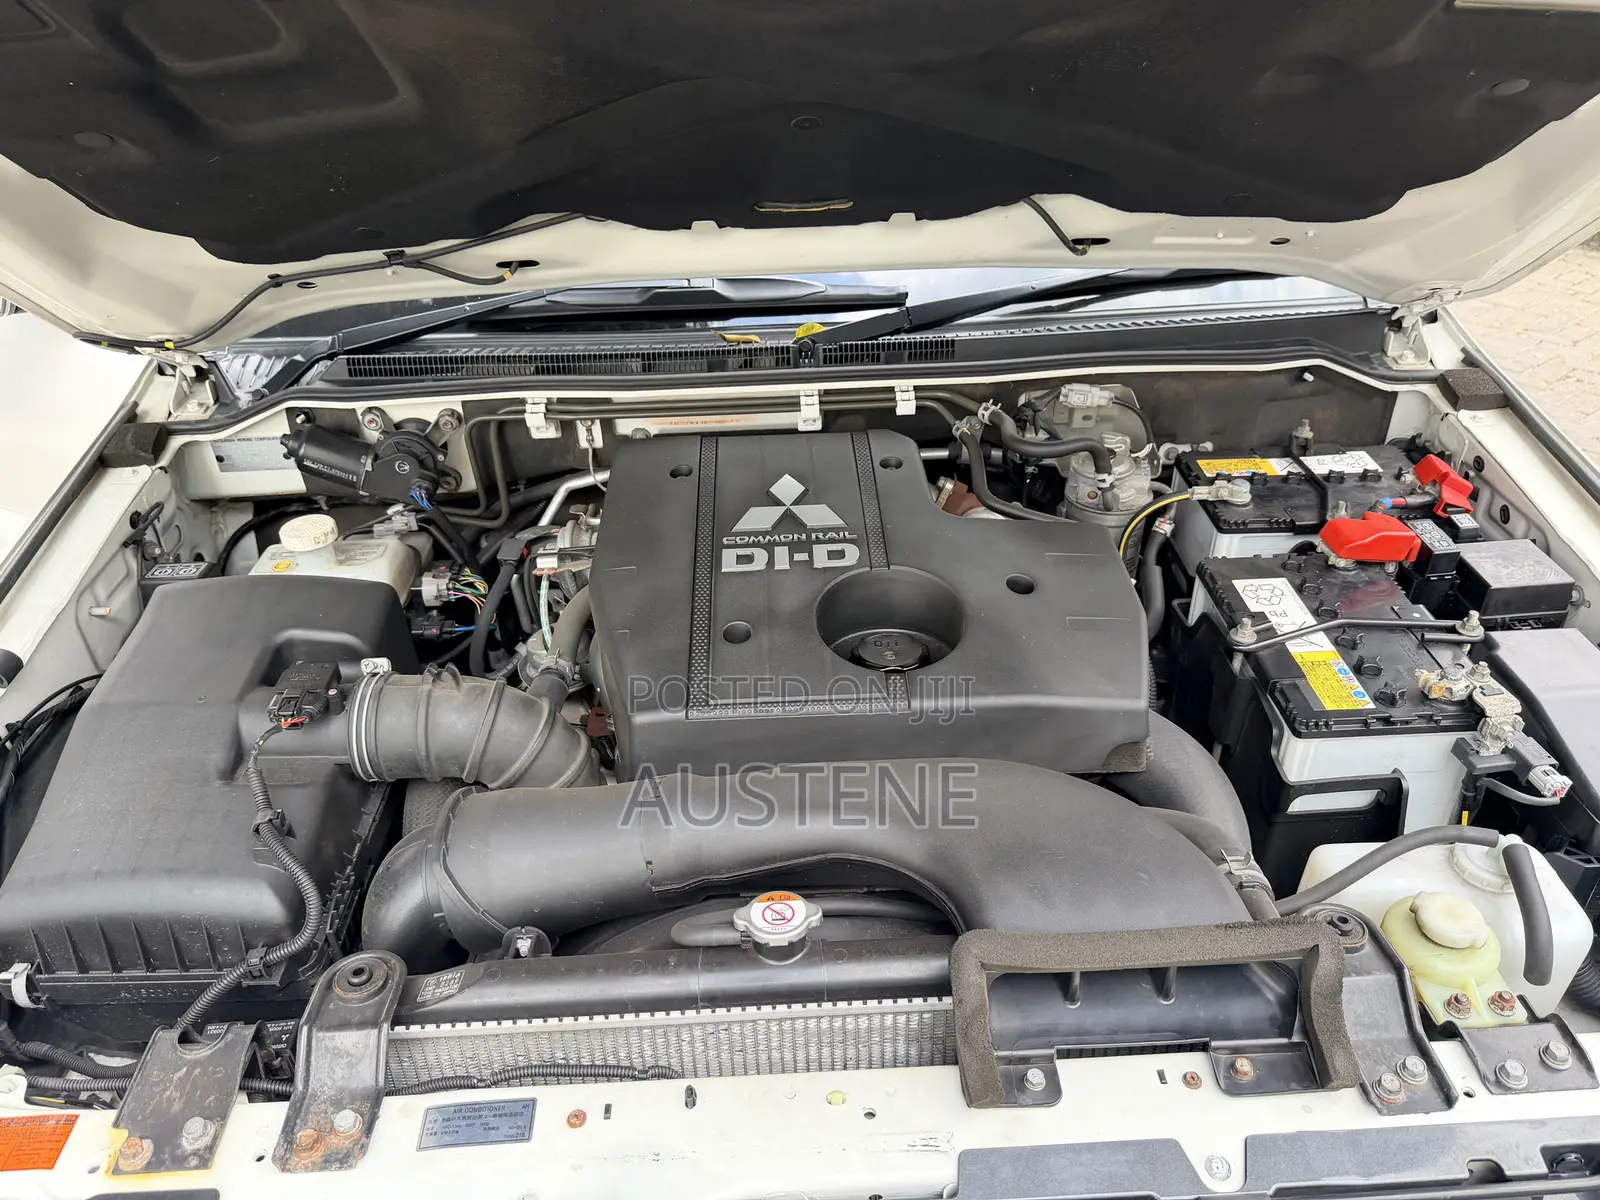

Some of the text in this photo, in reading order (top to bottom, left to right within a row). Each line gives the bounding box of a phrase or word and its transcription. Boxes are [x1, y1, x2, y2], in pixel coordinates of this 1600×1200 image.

[722, 531, 858, 545] COMMON RAIL
[721, 543, 860, 572] DI-D
[452, 1104, 507, 1115] AIR CONDITIONER
